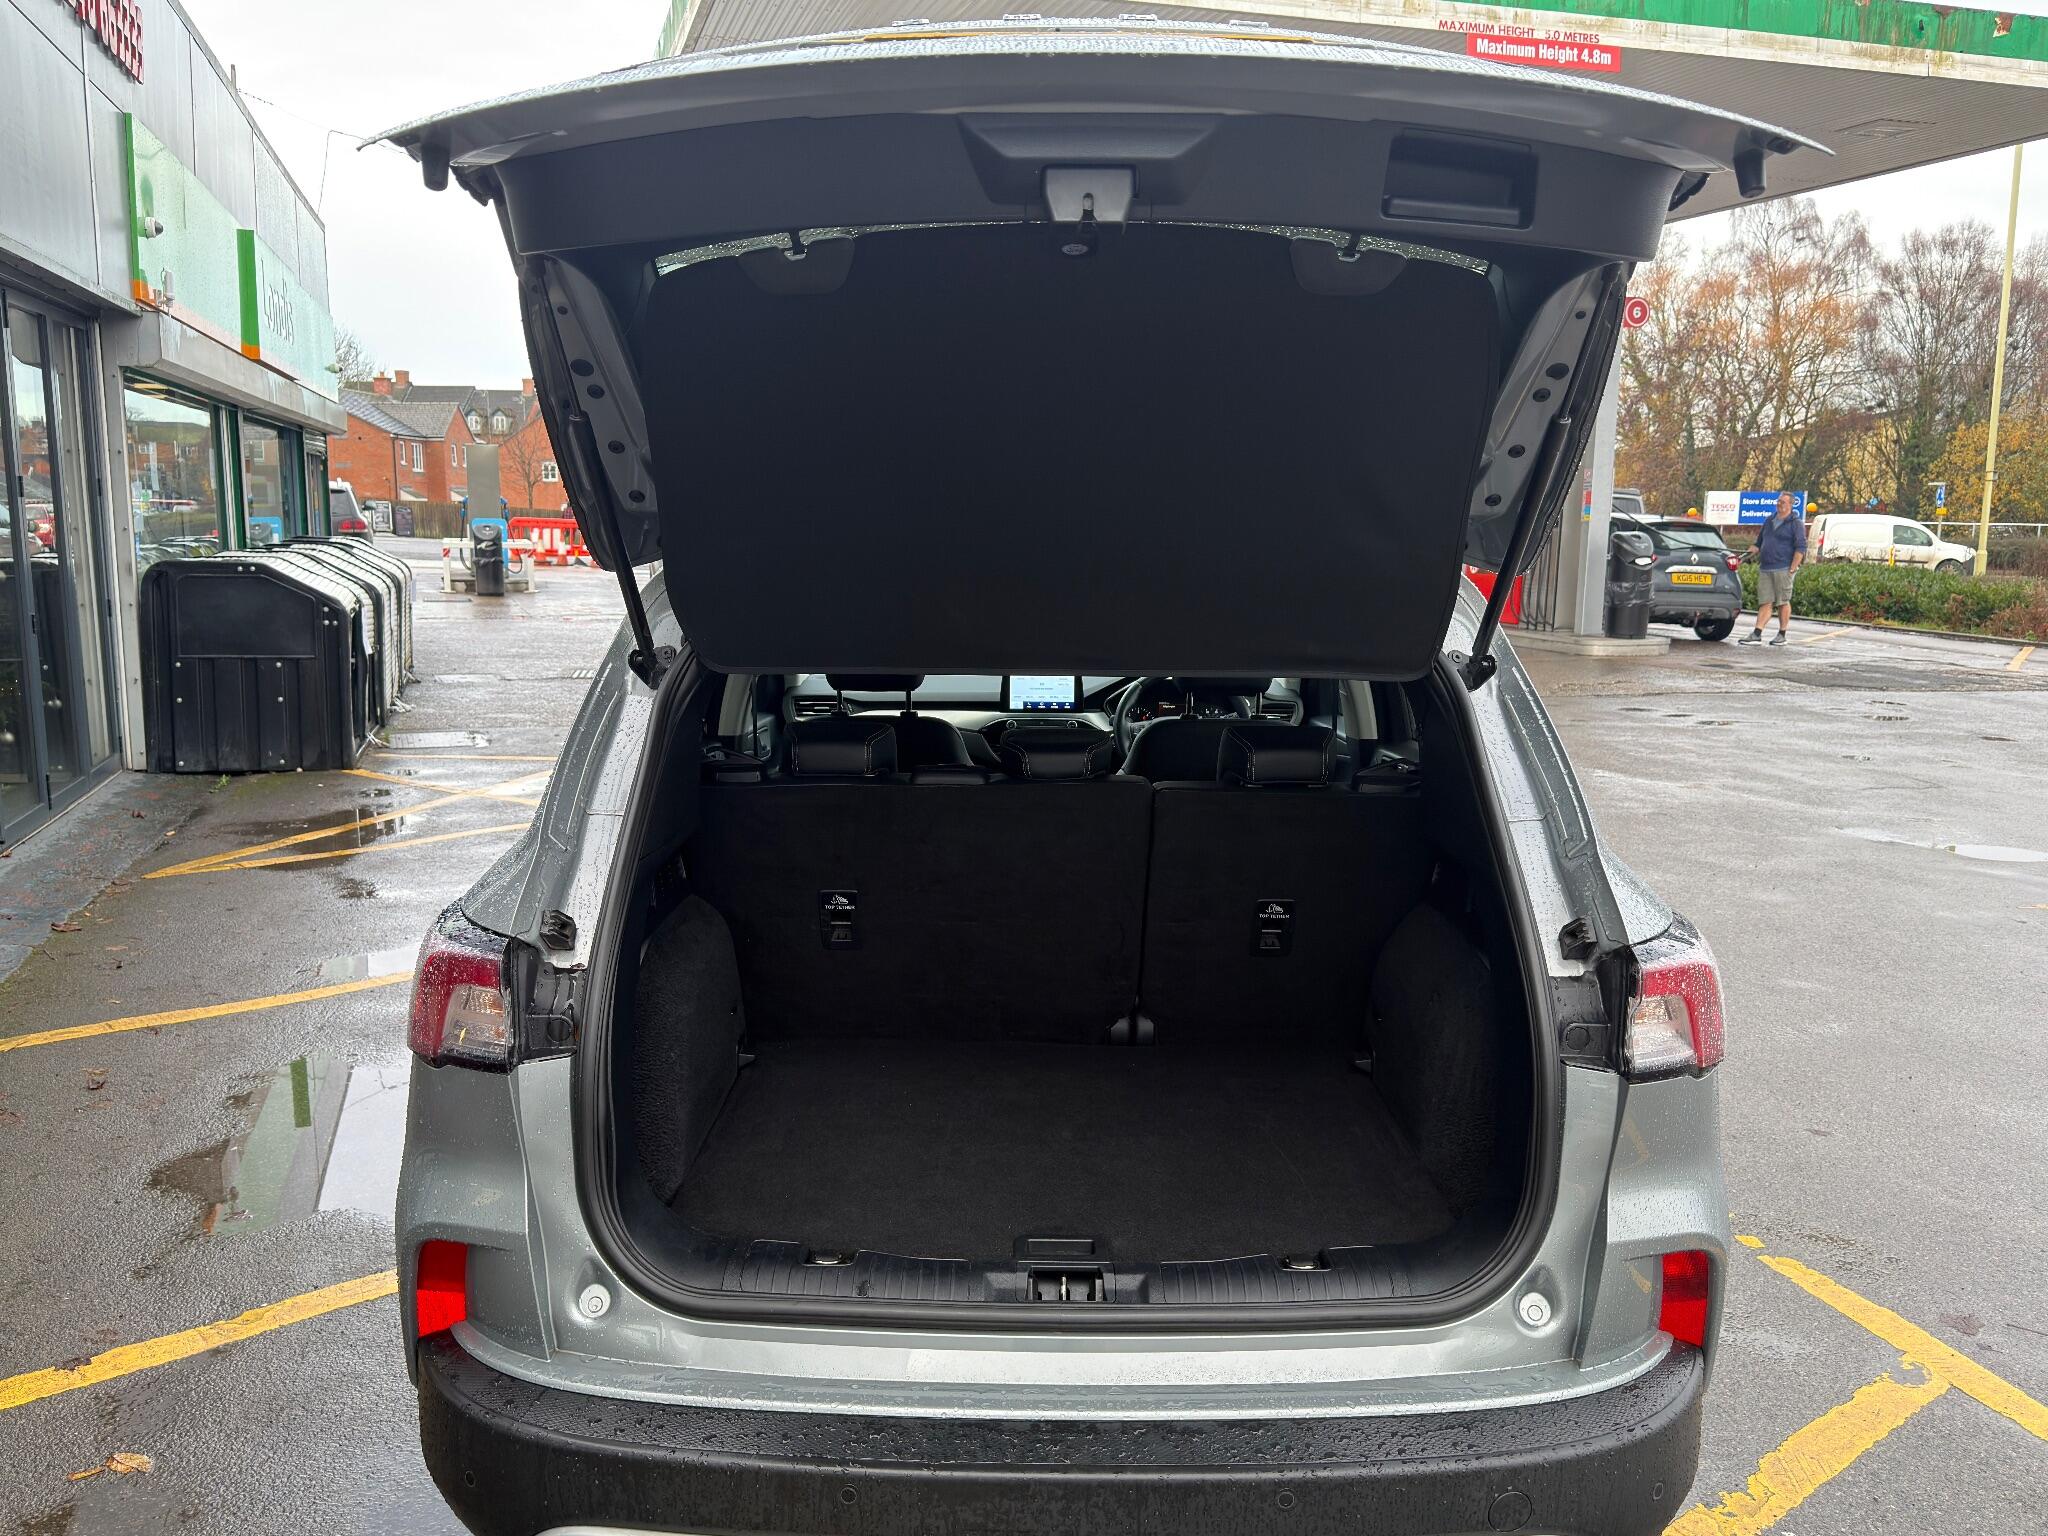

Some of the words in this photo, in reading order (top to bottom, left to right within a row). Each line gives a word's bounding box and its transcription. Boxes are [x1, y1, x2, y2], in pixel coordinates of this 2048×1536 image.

[1438, 20, 1495, 34] MAXIMUM
[1498, 25, 1536, 38] HEIGHT
[1545, 29, 1561, 40] 5.0
[1563, 32, 1600, 44] METRES
[1476, 38, 1536, 58] Maximum
[1538, 44, 1579, 63] Height
[1580, 48, 1612, 65] 4.8m
